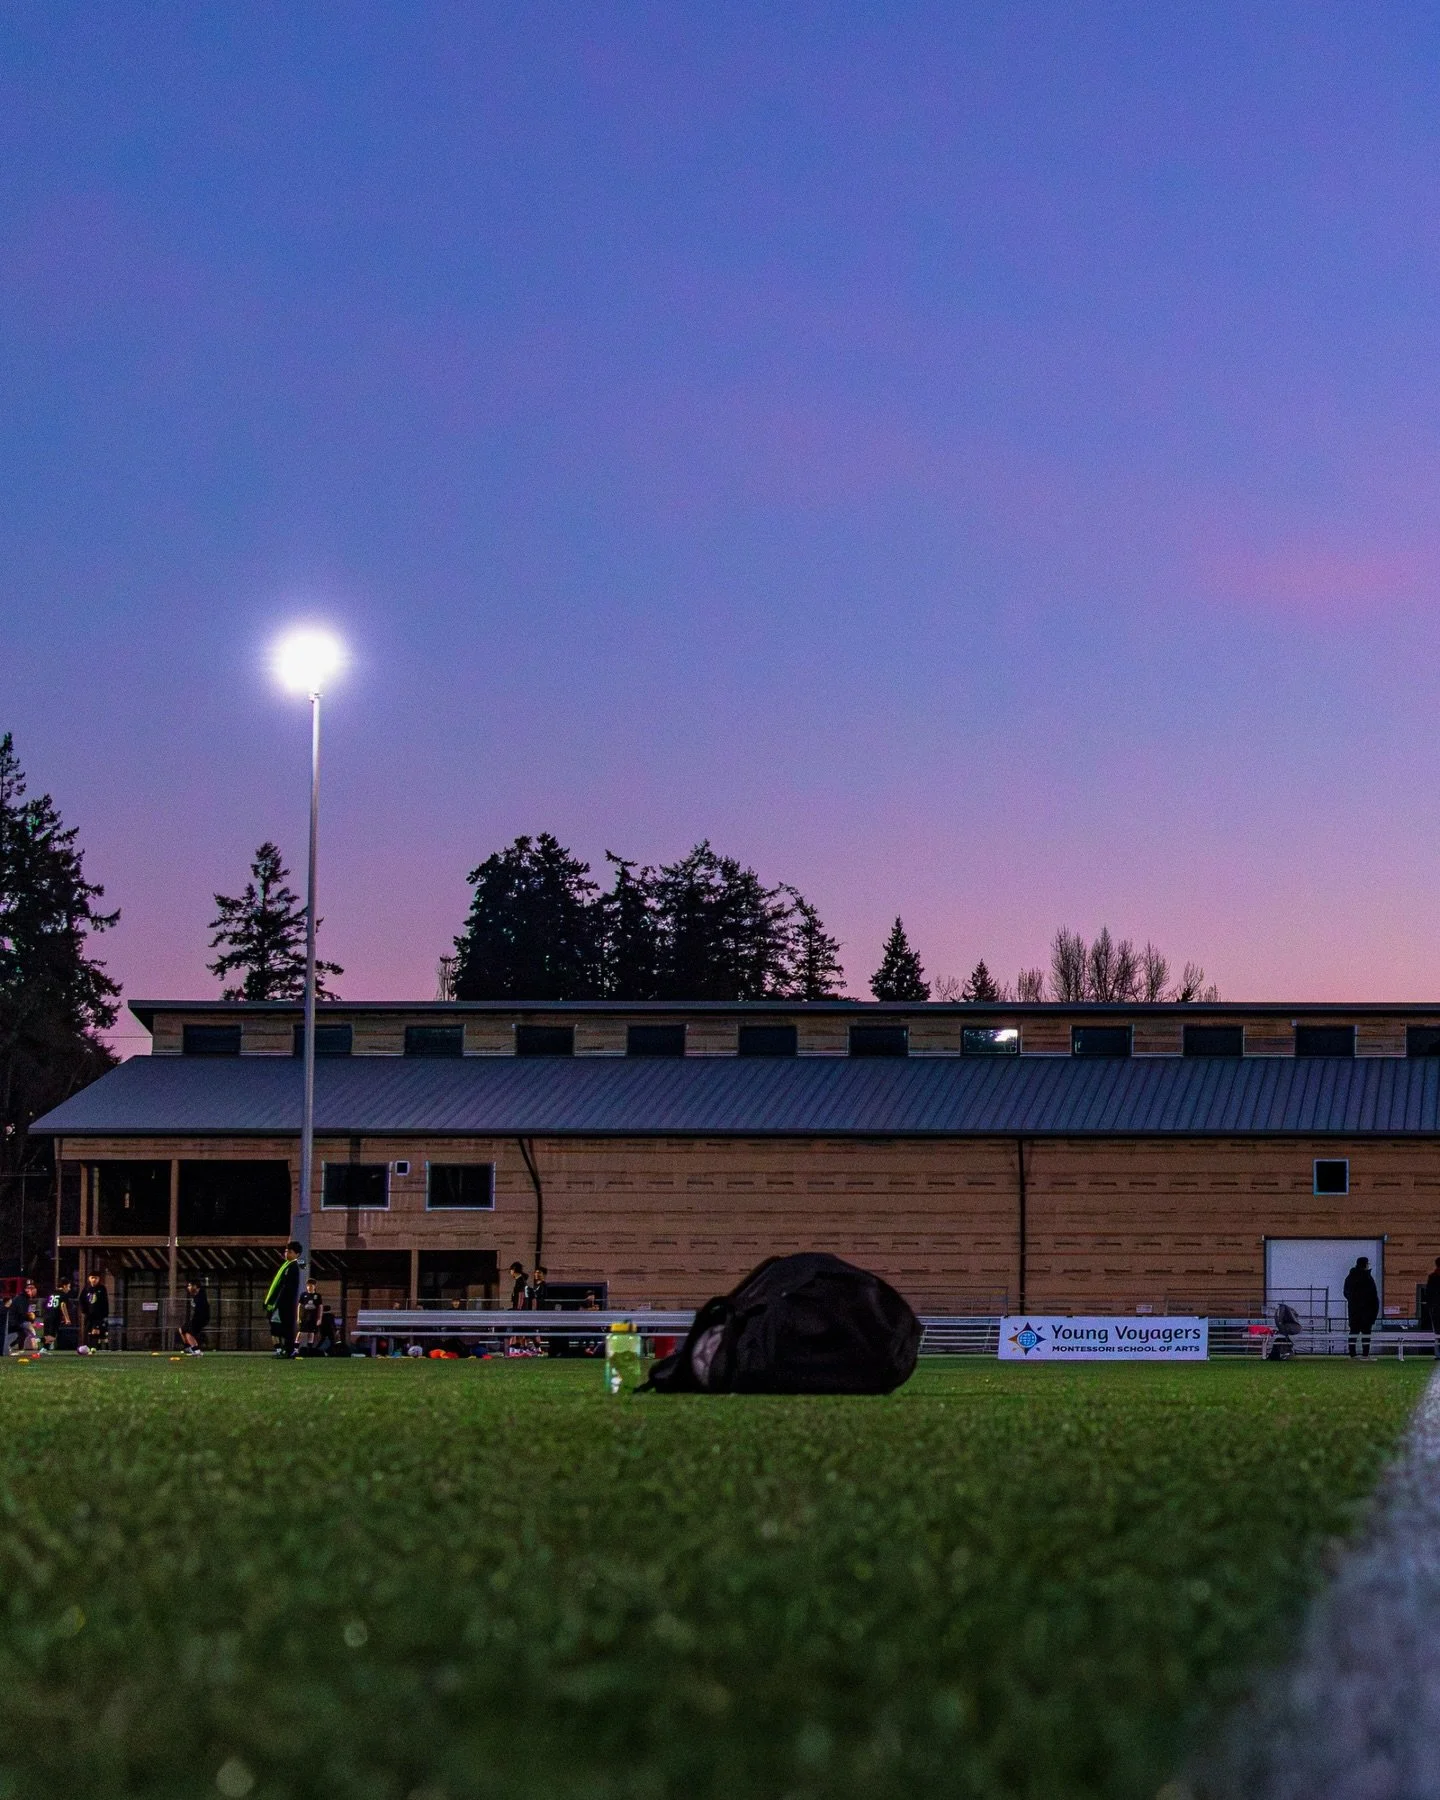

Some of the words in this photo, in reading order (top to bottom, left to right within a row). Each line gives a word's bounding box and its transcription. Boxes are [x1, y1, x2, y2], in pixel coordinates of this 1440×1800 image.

[47, 1294, 60, 1308] 35
[1051, 1324, 1109, 1344] Young
[1114, 1325, 1201, 1344] Voyagers
